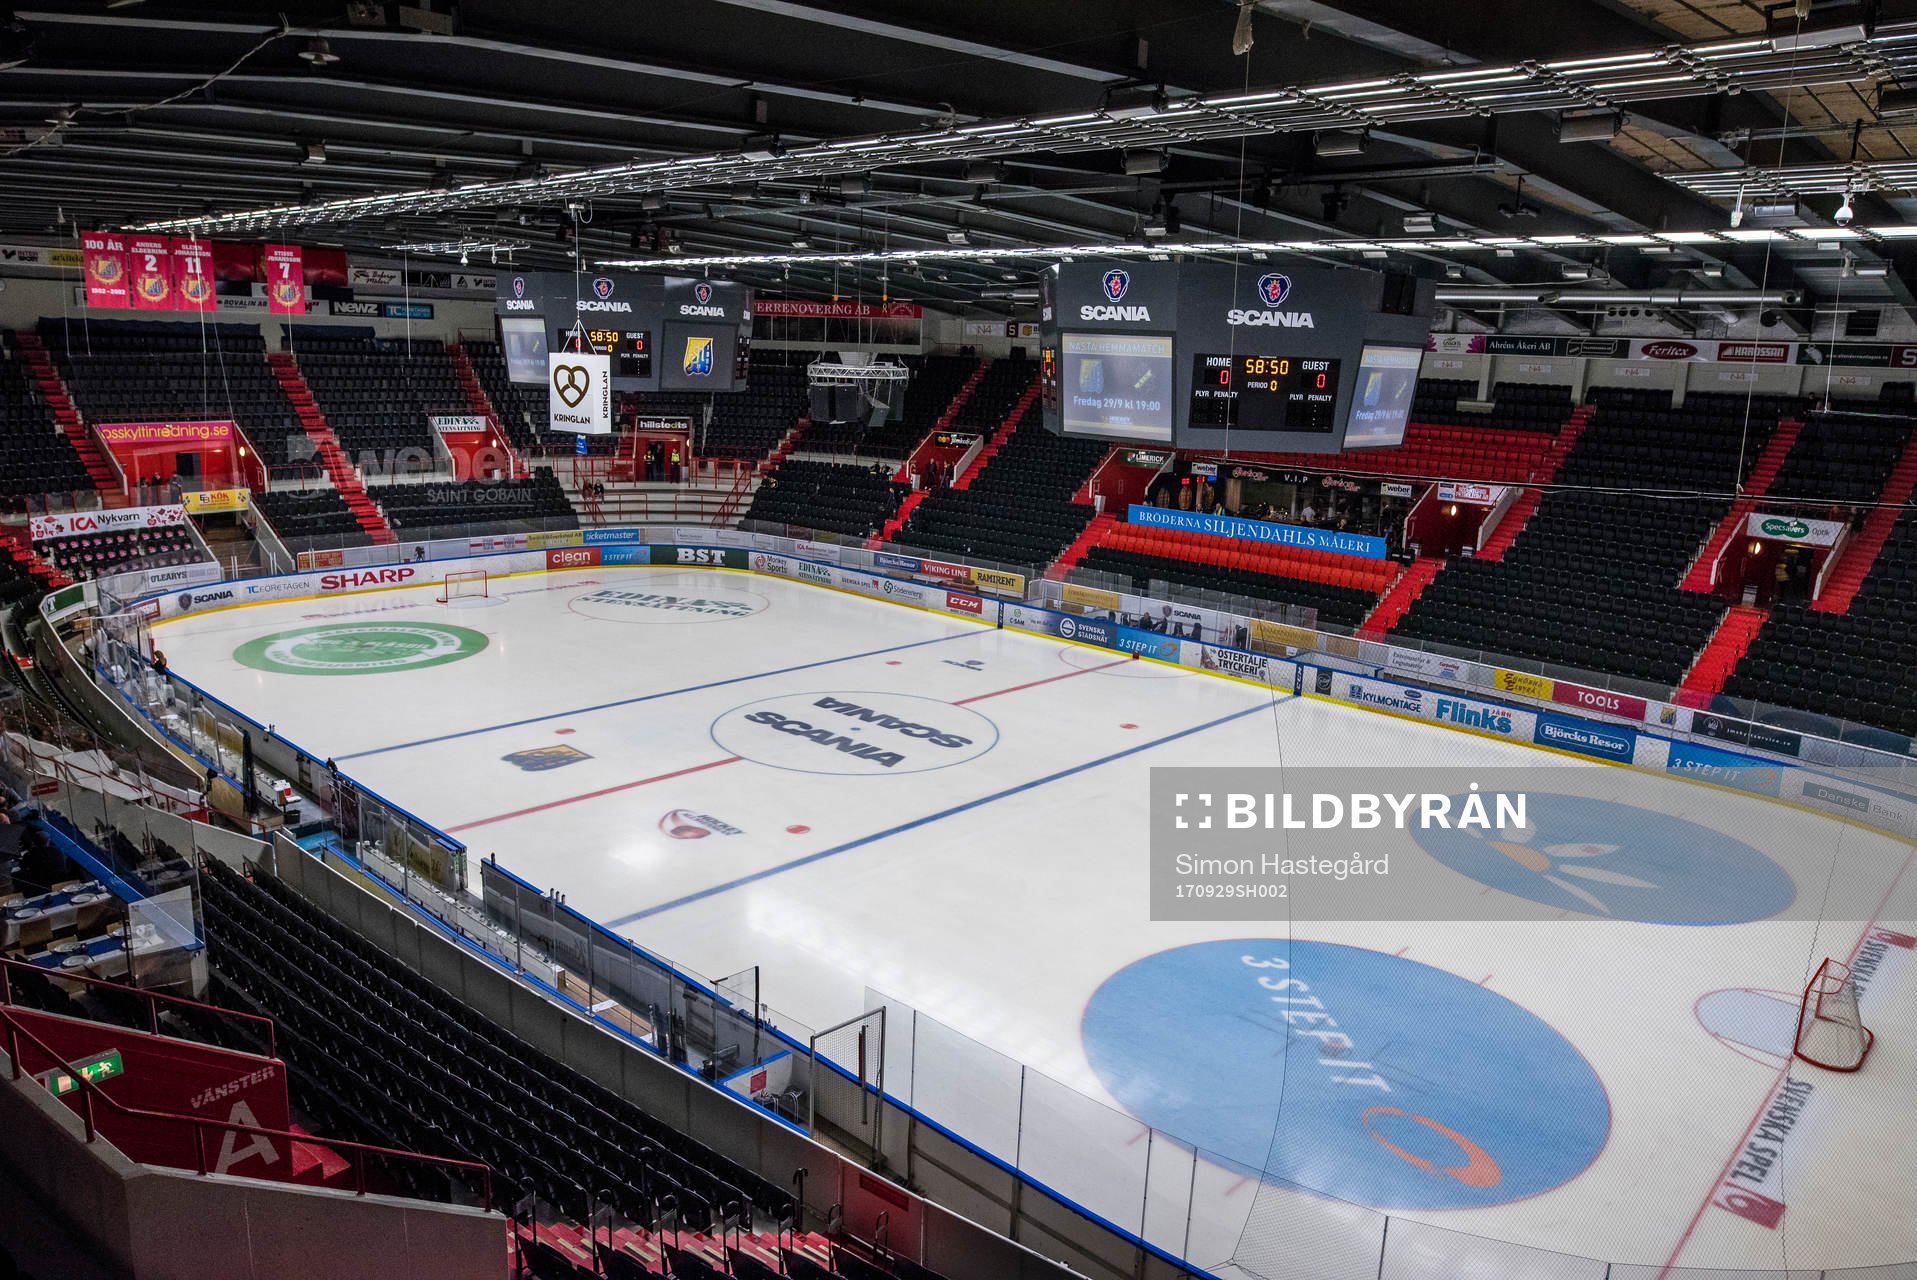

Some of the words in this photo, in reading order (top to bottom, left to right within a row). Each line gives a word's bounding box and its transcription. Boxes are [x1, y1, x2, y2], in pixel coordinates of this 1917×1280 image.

[84, 240, 104, 250] 100
[107, 238, 124, 252] ÅR
[144, 254, 158, 272] 2
[185, 257, 202, 274] 11
[279, 262, 290, 278] 7
[506, 300, 534, 310] SCANIA
[576, 300, 632, 313] SCANIA
[680, 304, 725, 318] SCANIA
[855, 305, 870, 315] AB
[1080, 305, 1151, 322] SCANIA
[1226, 309, 1314, 328] SCANIA
[590, 331, 619, 342] 58:50
[626, 332, 644, 340] GUEST
[608, 344, 613, 352] 0
[636, 340, 643, 350] 0
[1539, 342, 1551, 350] AB
[1649, 344, 1690, 356] Feritex
[1206, 357, 1232, 367] HOME
[1246, 358, 1289, 375] 58:50
[1302, 361, 1330, 371] GUEST
[1220, 370, 1229, 385] 0
[1316, 373, 1326, 388] 0
[1270, 380, 1278, 392] 0
[1214, 390, 1238, 398] PENALTY
[1308, 394, 1332, 402] PENALTY
[1073, 395, 1101, 409] Fredag
[1104, 398, 1123, 408] 29/9
[1125, 399, 1134, 409] kl
[1136, 400, 1160, 410] 19:00
[438, 416, 468, 425] EDINA
[554, 413, 591, 425] KRINGLAN
[640, 420, 688, 430] hillstedts
[1136, 454, 1164, 463] LIMERICK
[1196, 464, 1217, 473] weber
[427, 488, 468, 502] SAINT
[473, 487, 533, 502] GOBAIN
[1387, 484, 1411, 494] weber
[70, 516, 98, 533] ICA
[98, 512, 140, 525] Nykvarn
[1765, 522, 1805, 534] Specsavers
[1812, 527, 1830, 537] Optik
[586, 530, 635, 541] ticketmaster
[1139, 510, 1201, 529] BRÖDERNA
[1204, 518, 1316, 546] SILJENDAHLS
[1318, 534, 1372, 553] MÅLERI
[552, 551, 591, 564] clean
[676, 548, 726, 564] BST
[767, 554, 787, 565] Monkey
[766, 563, 788, 574] Sports
[924, 564, 950, 576] VIKING
[951, 568, 968, 578] LINE
[320, 568, 415, 590] SHARP
[976, 572, 1016, 587] RAMIRENT
[194, 588, 234, 604] SCANIA
[950, 597, 979, 609] CCM
[1174, 610, 1202, 620] SCANIA
[1078, 623, 1106, 636] SVENSKA
[1120, 638, 1125, 648] 3
[1126, 640, 1147, 653] STEP
[1148, 644, 1158, 655] IT
[1218, 658, 1259, 676] TRYCKERI
[1362, 692, 1422, 712] KYLMONTAGE
[1578, 691, 1620, 710] TOOLS
[813, 696, 973, 749] SCANIA
[1436, 698, 1512, 734] Flinks
[744, 711, 906, 768] SCANIA
[1544, 725, 1588, 742] Björcks
[1588, 735, 1625, 751] Resor
[1672, 758, 1682, 769] 3
[1684, 760, 1721, 777] STEP
[1724, 768, 1741, 782] IT
[1818, 788, 1866, 810] Danske
[1872, 804, 1903, 822] Bank
[1240, 955, 1290, 969] 3
[1257, 976, 1354, 1049] STEP
[1318, 1058, 1392, 1093] IT
[190, 1066, 276, 1109] VÄNSTER
[1754, 1076, 1814, 1144] SVENSKA
[214, 1099, 280, 1175] A
[1729, 1141, 1779, 1184] SPEL
